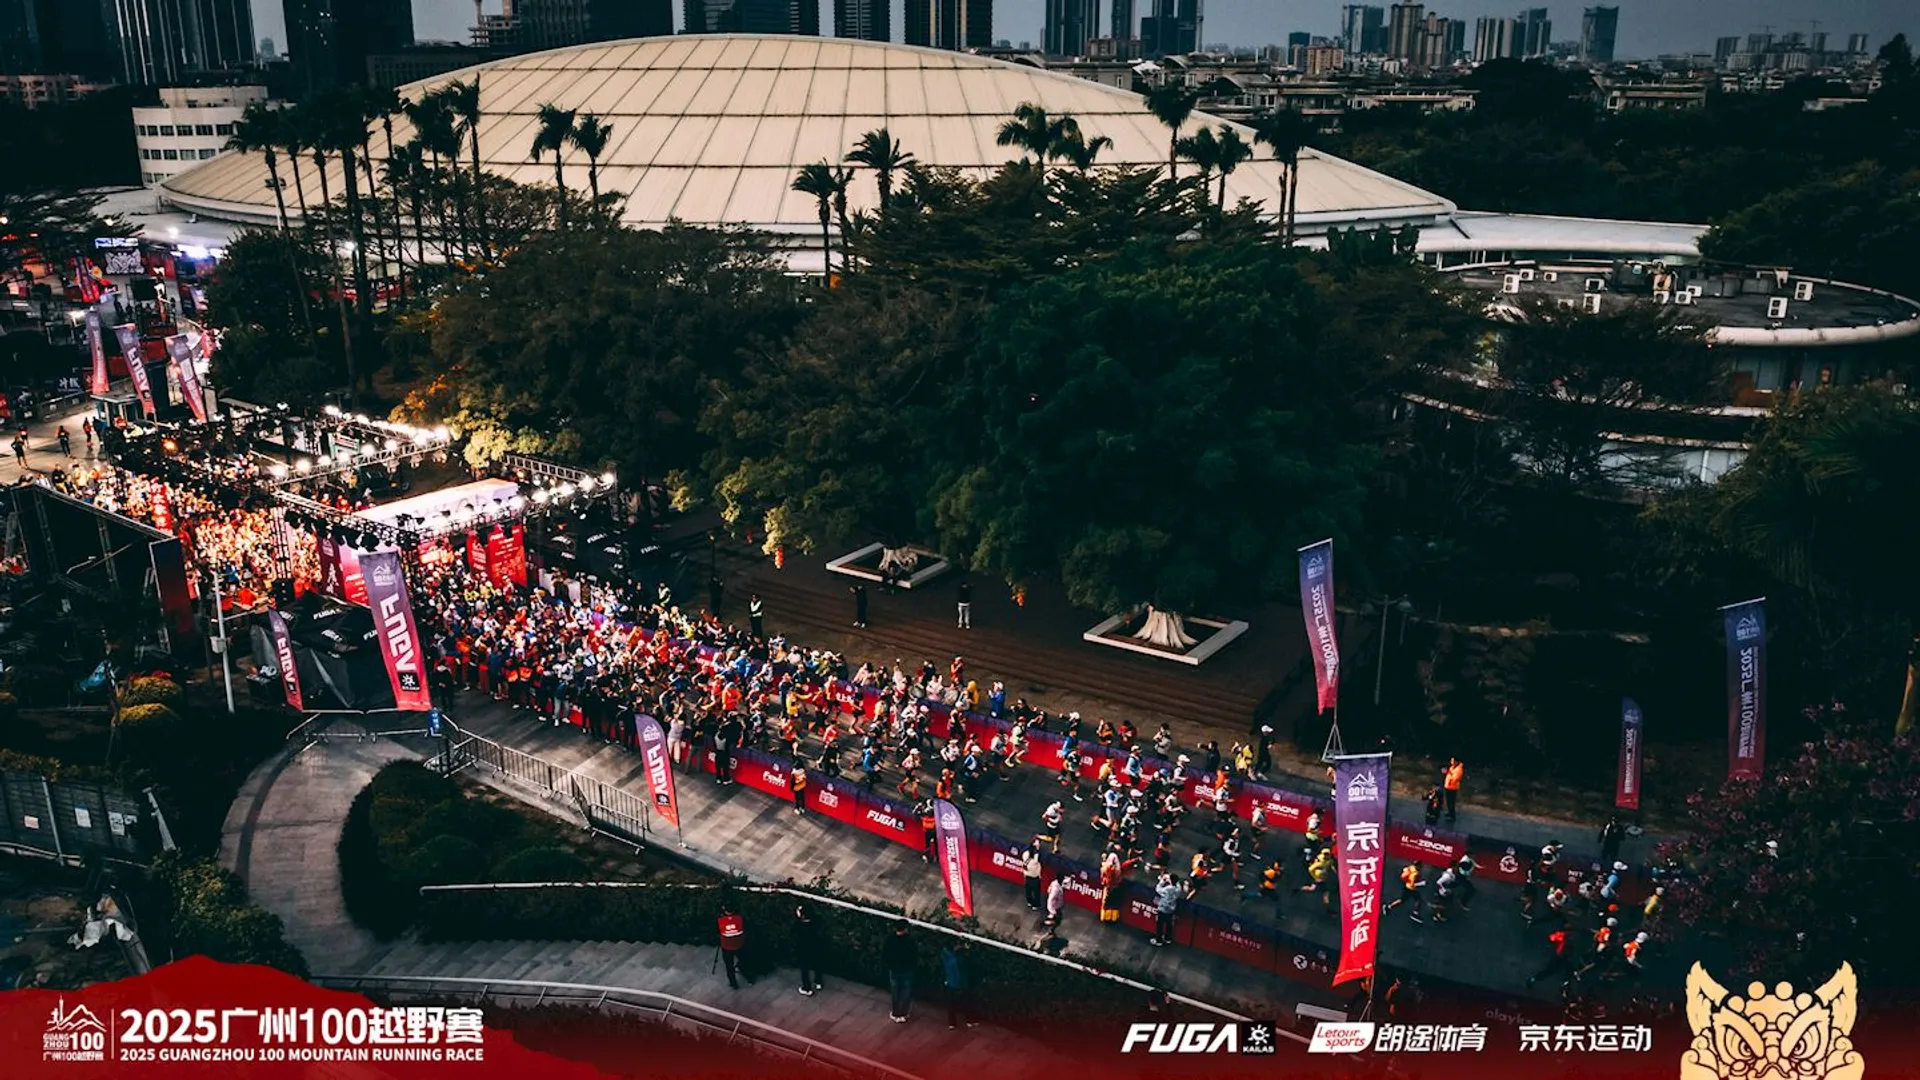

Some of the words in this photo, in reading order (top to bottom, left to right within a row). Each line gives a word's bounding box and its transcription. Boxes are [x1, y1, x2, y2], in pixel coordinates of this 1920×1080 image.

[866, 810, 897, 830] FUGA
[1071, 879, 1103, 900] injinji
[1132, 900, 1159, 914] NITEC
